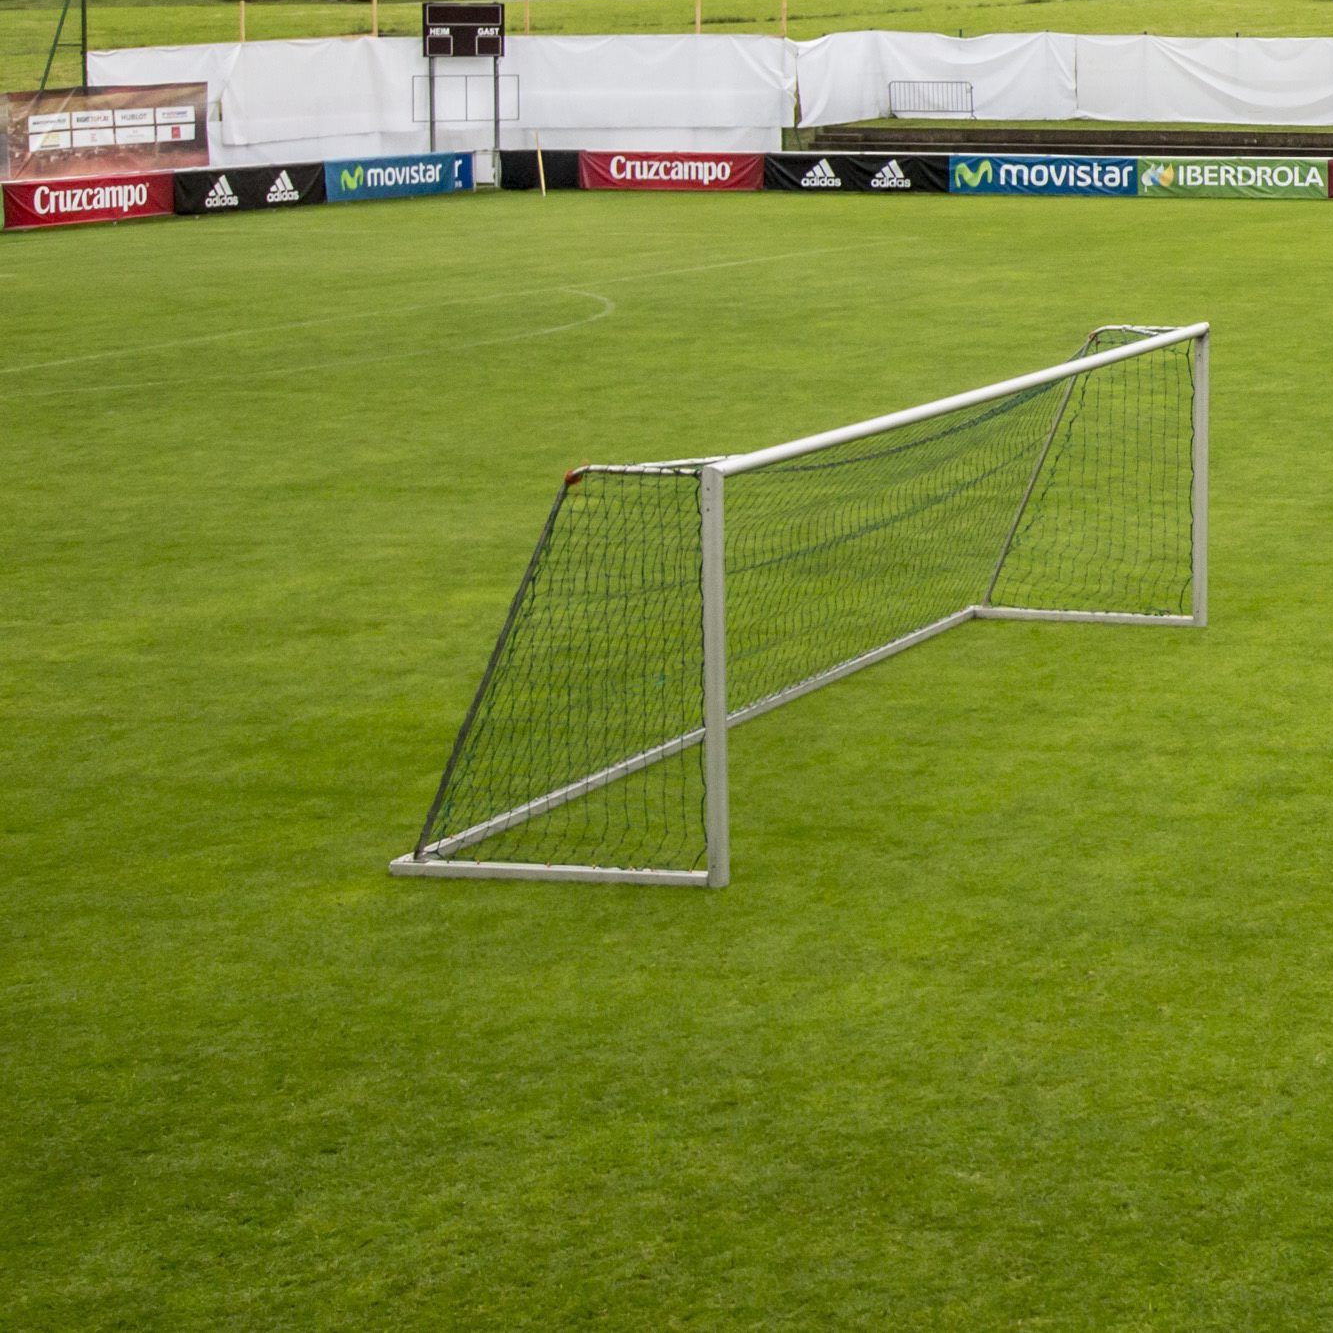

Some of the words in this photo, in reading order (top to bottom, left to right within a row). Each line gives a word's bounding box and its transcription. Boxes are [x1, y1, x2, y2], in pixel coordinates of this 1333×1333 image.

[478, 28, 500, 36] GAST
[366, 162, 443, 187] movistar
[609, 155, 730, 185] Cruzcampo
[999, 162, 1134, 188] movistar
[1177, 164, 1324, 187] IBERDROLA
[801, 176, 841, 188] adidas
[871, 177, 911, 188] adidas
[33, 183, 148, 215] Cruzcampo
[205, 194, 239, 208] adidas
[266, 190, 300, 203] adidas
